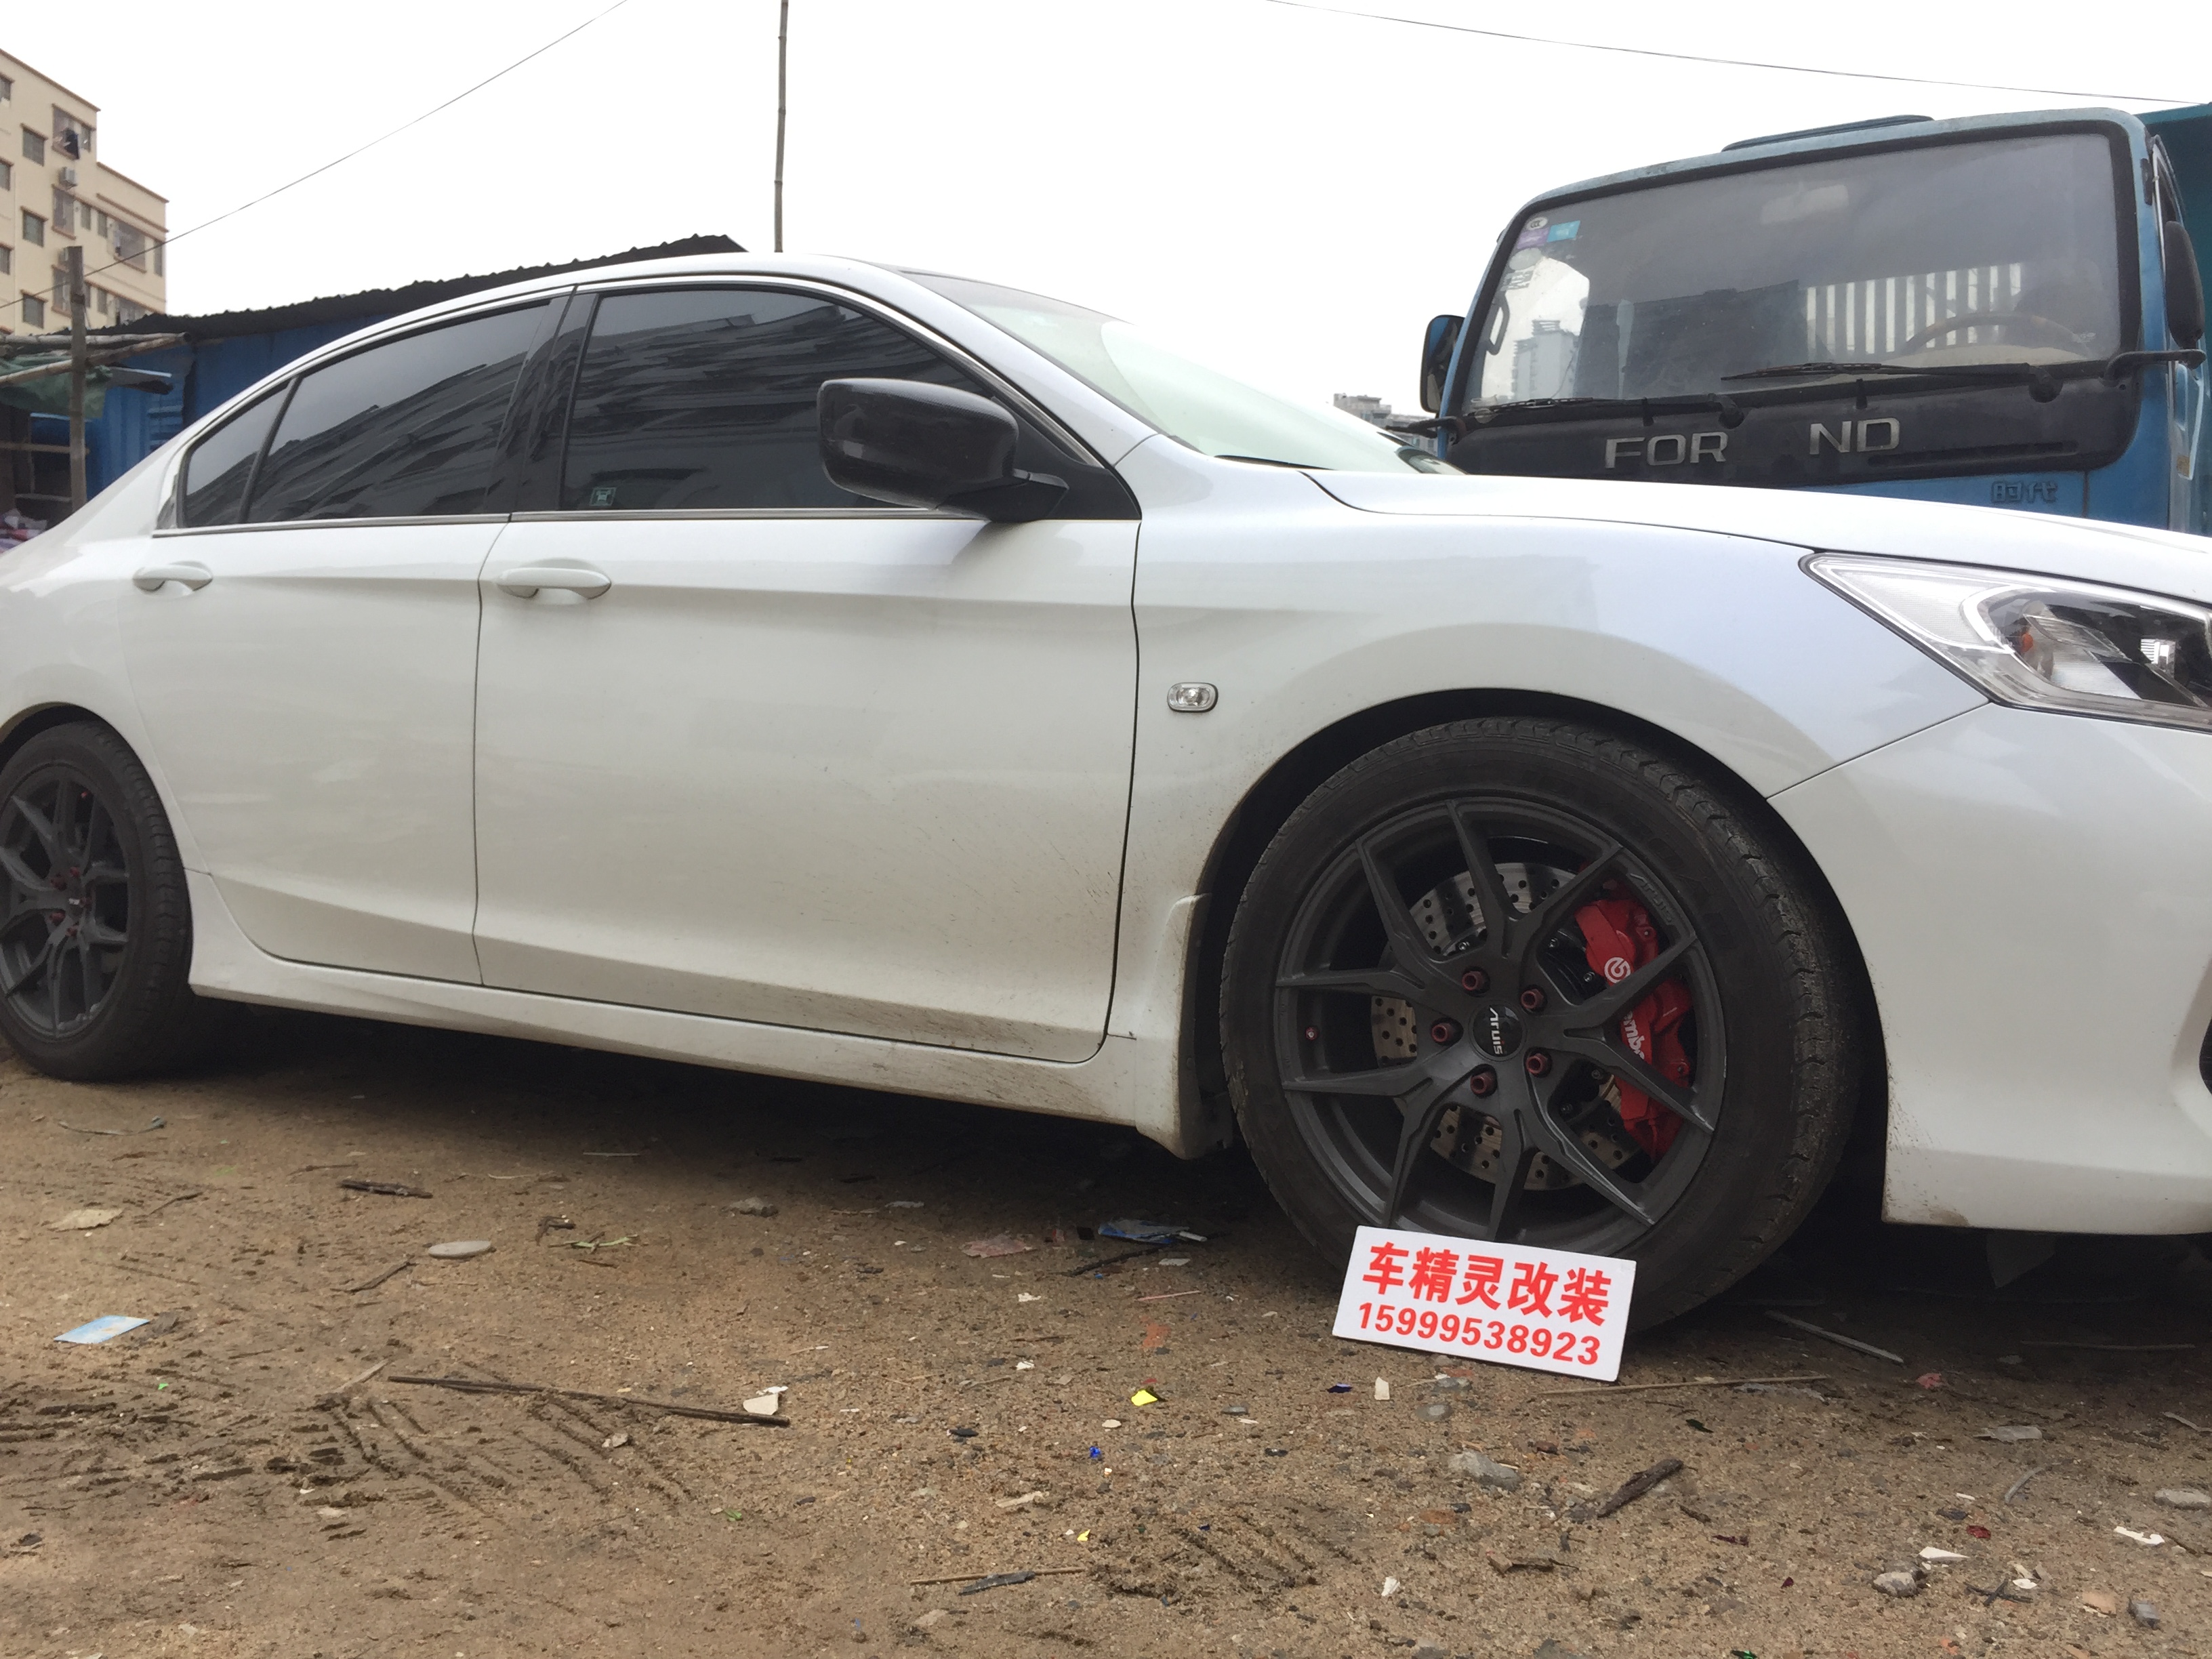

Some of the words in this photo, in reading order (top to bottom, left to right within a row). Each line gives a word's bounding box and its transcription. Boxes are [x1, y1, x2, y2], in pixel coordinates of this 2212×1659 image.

[1991, 480, 2058, 503] 时代
[1362, 1241, 1612, 1326] 车精灵改装
[1358, 1301, 1601, 1366] 15999538923
